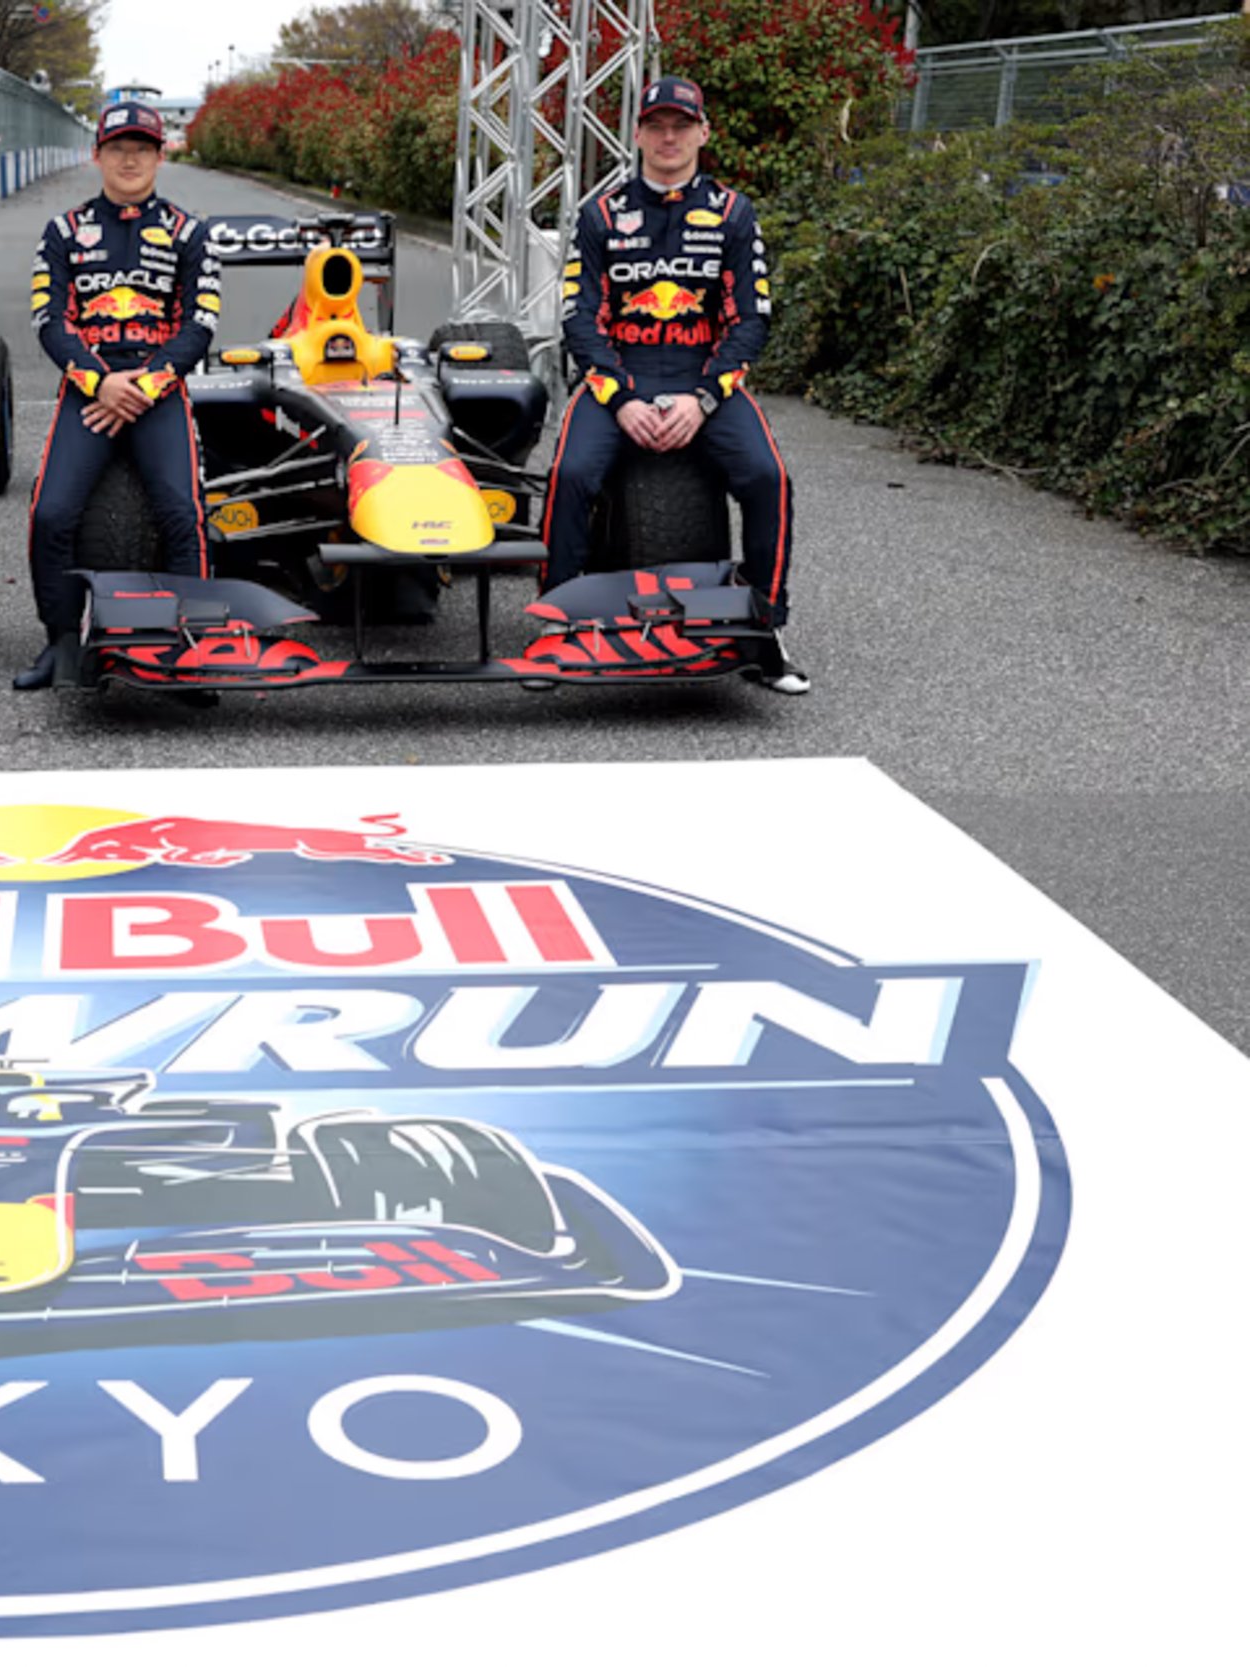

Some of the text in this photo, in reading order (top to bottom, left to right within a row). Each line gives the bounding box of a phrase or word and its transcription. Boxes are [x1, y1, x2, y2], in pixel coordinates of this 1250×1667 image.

[74, 269, 174, 293] ORACLE
[608, 257, 722, 282] ORACLE
[56, 882, 608, 972] Bull
